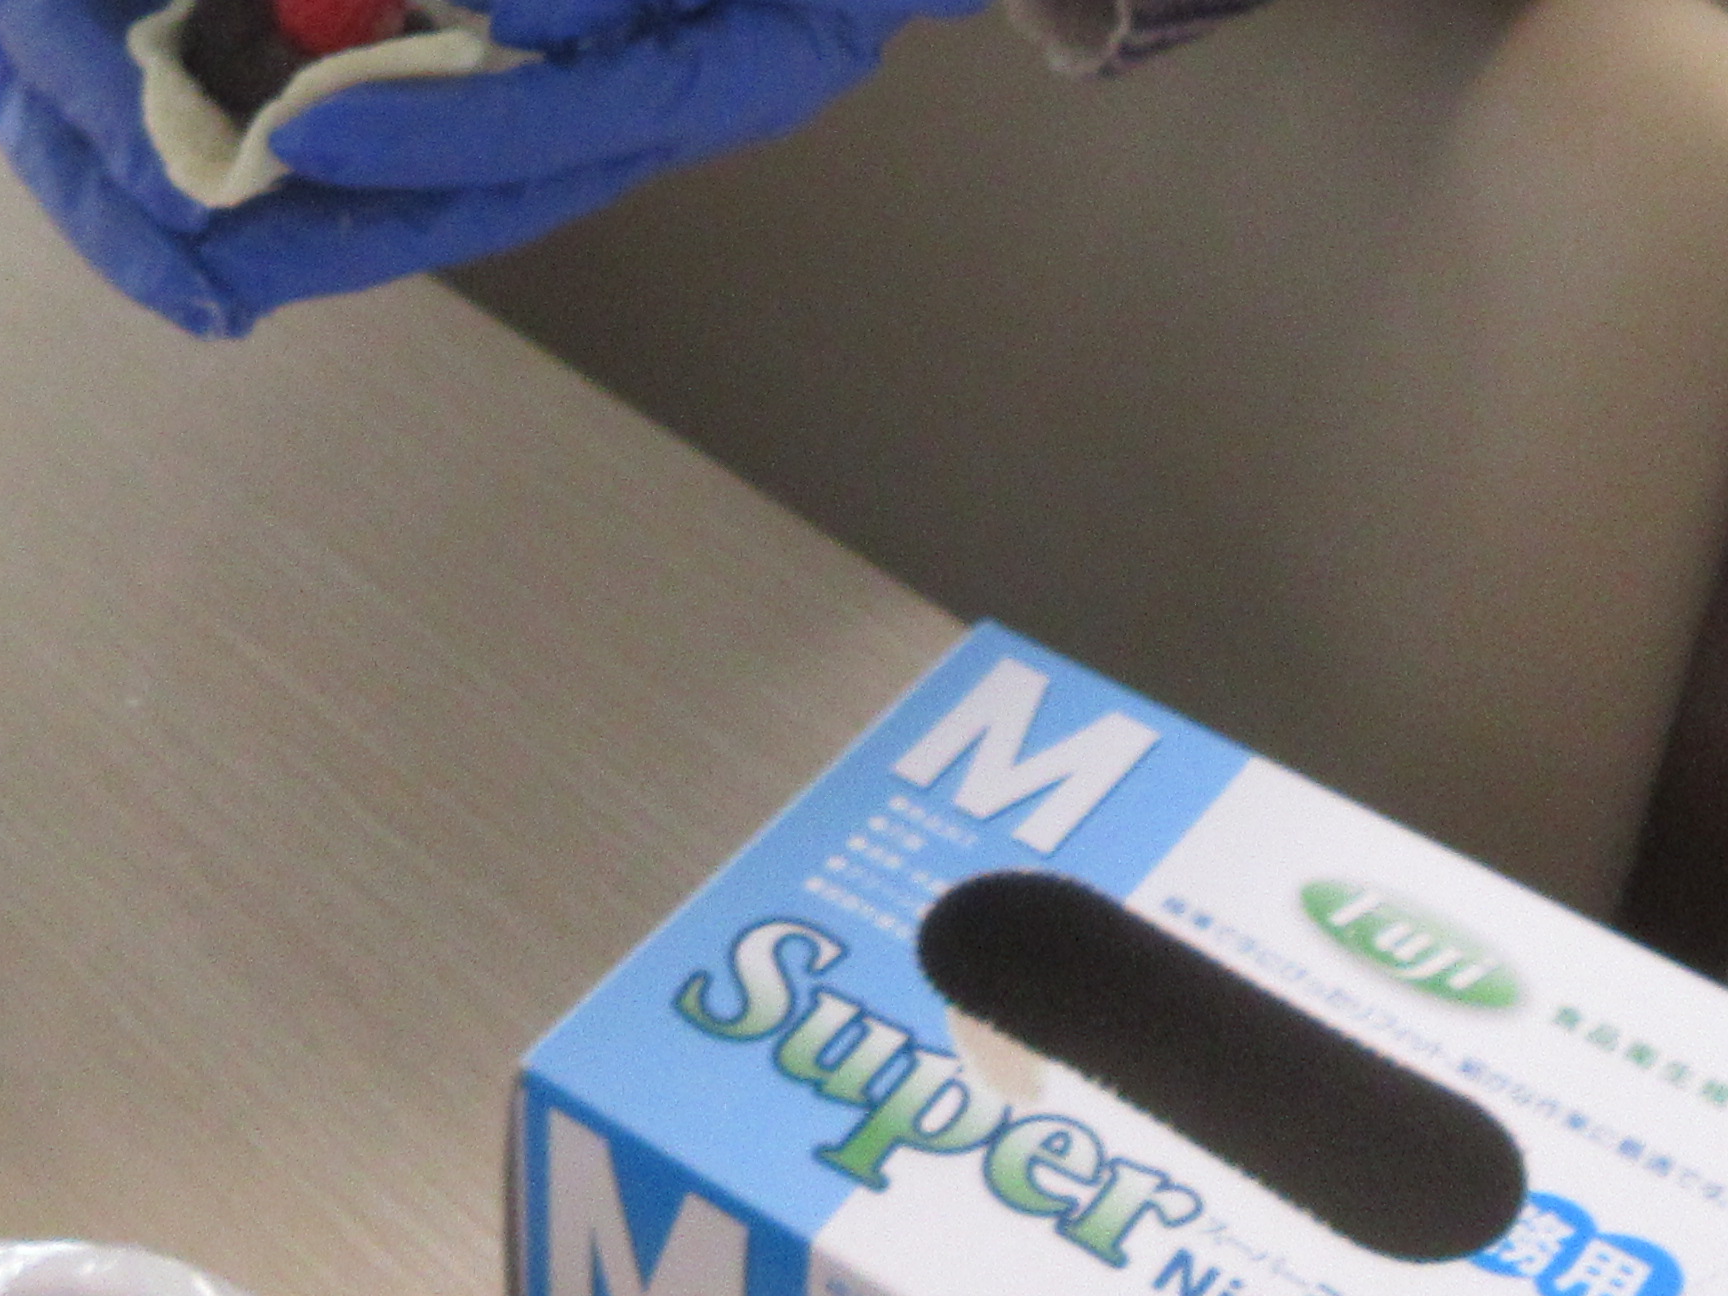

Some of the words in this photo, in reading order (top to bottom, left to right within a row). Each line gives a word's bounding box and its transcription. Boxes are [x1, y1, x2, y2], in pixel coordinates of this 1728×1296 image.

[892, 656, 1160, 854] M
[1330, 888, 1500, 990] Fuji
[674, 916, 1204, 1269] Super
